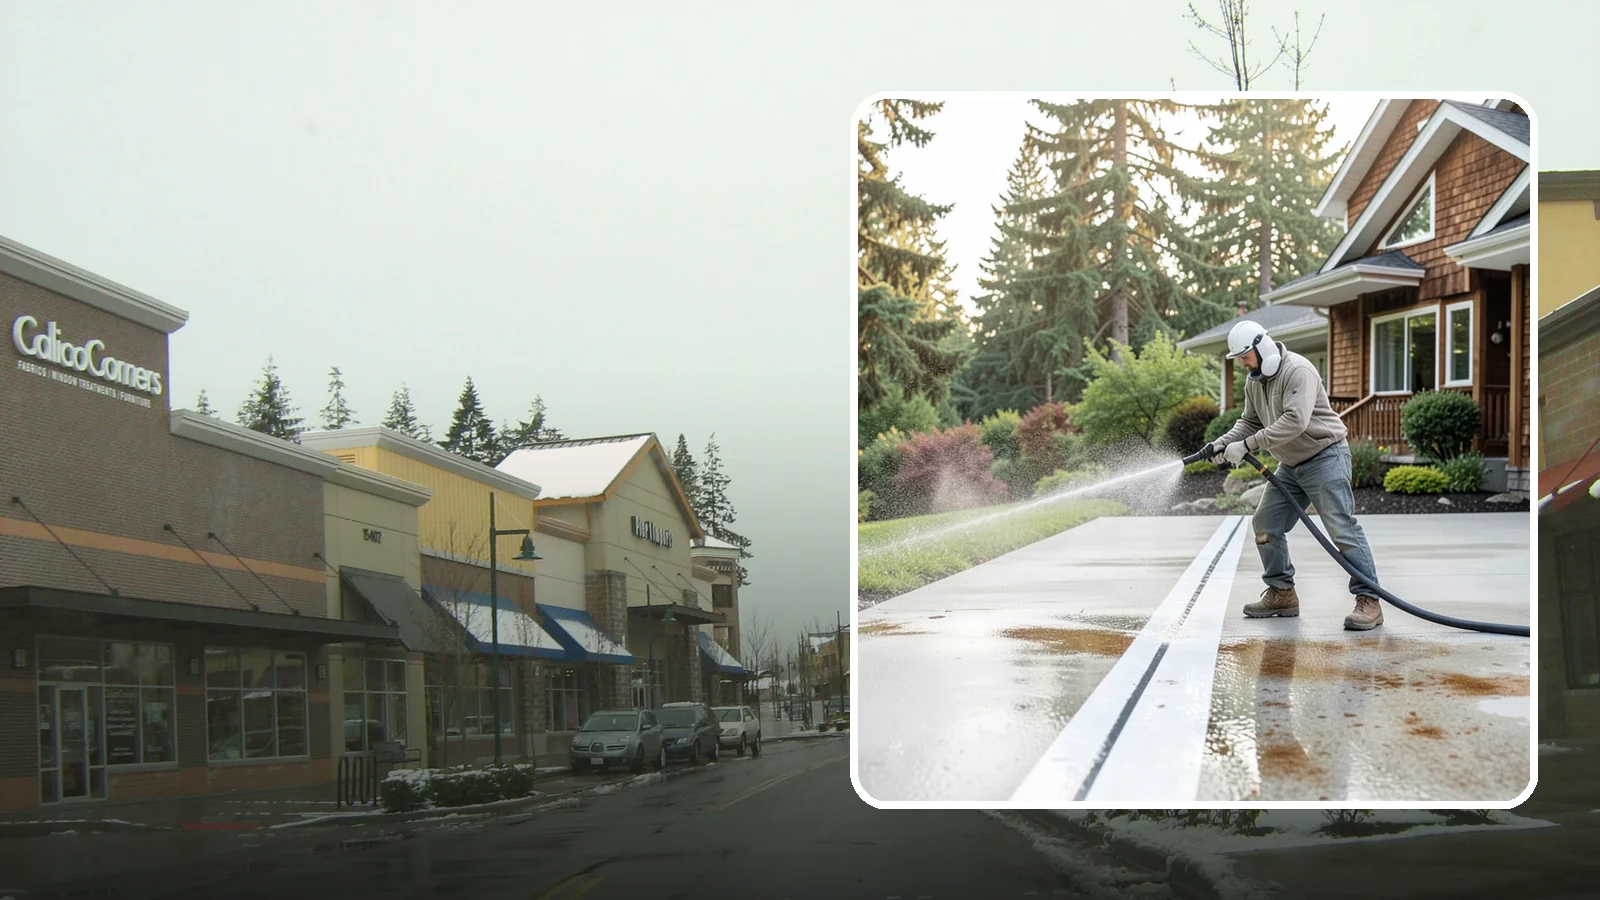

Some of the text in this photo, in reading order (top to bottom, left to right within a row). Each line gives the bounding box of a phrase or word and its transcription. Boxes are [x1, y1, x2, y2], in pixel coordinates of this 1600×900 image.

[16, 360, 47, 377] FABRICS
[51, 370, 78, 387] WINDOW
[78, 378, 116, 398] TREATMENTS
